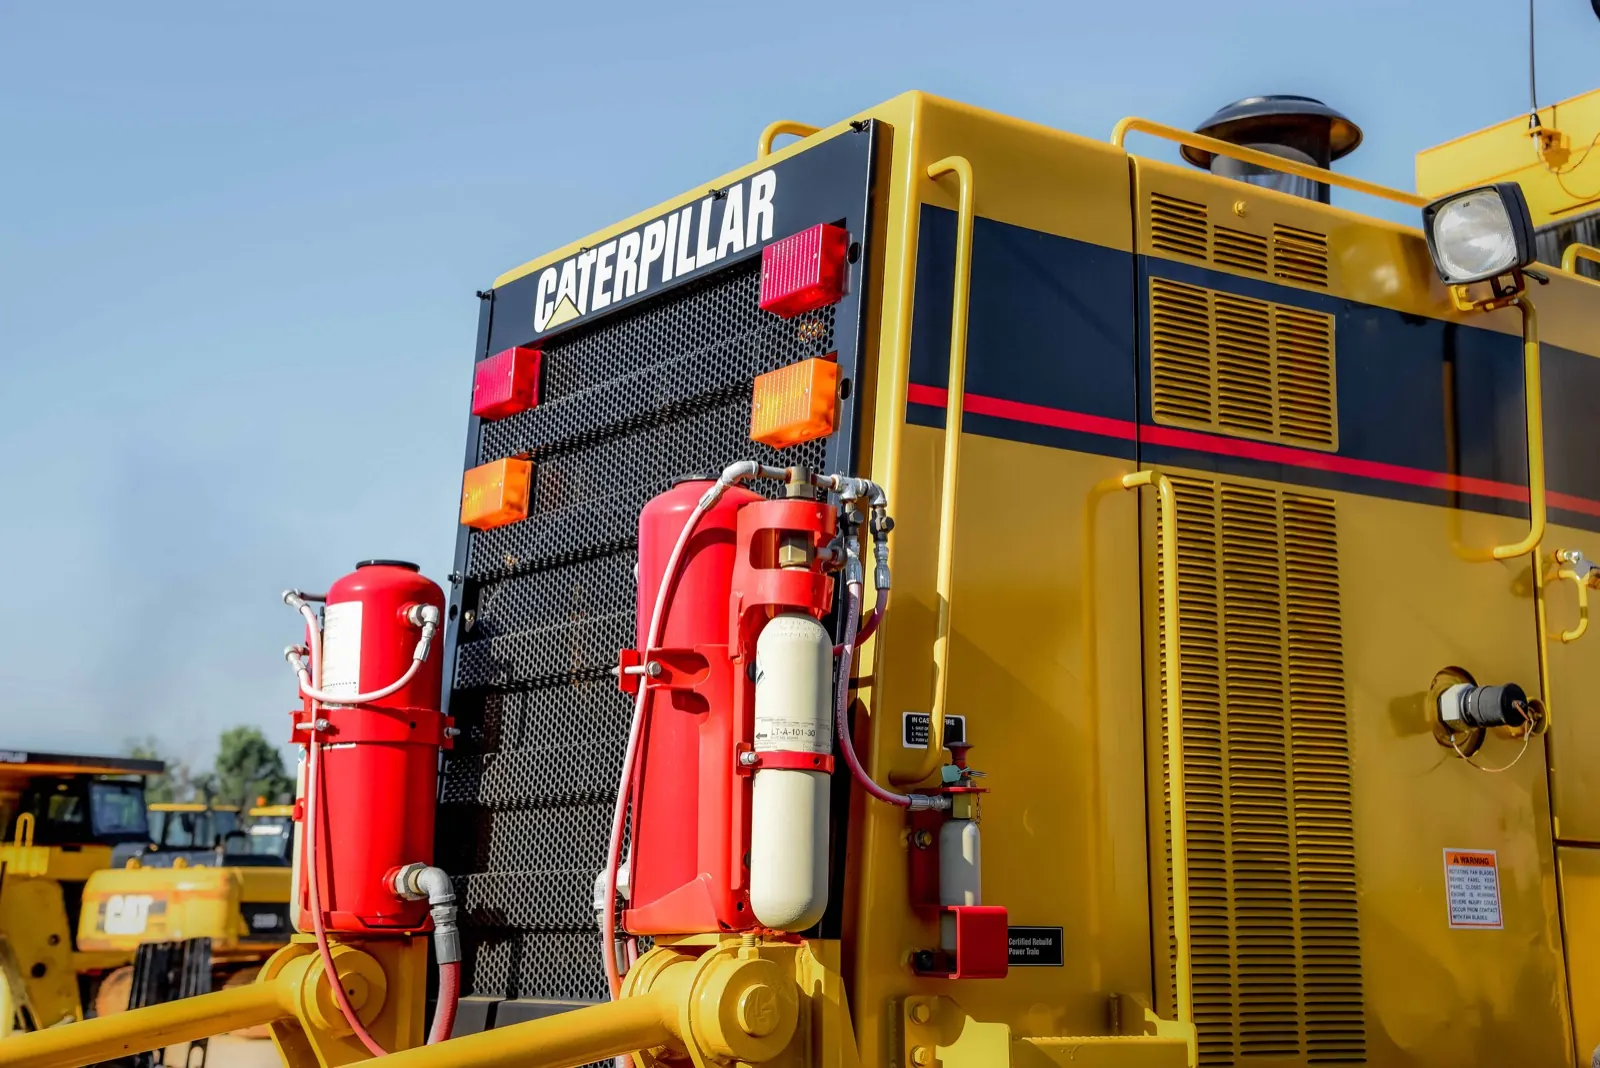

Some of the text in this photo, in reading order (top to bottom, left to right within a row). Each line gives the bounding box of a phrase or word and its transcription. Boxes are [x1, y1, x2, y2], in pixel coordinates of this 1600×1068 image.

[534, 169, 776, 333] CATERPILLAR
[771, 727, 816, 737] LT-A-101-30
[1460, 856, 1489, 865] WARNING
[1008, 937, 1052, 945] Certified Rebuild
[1008, 947, 1039, 955] Power Train
